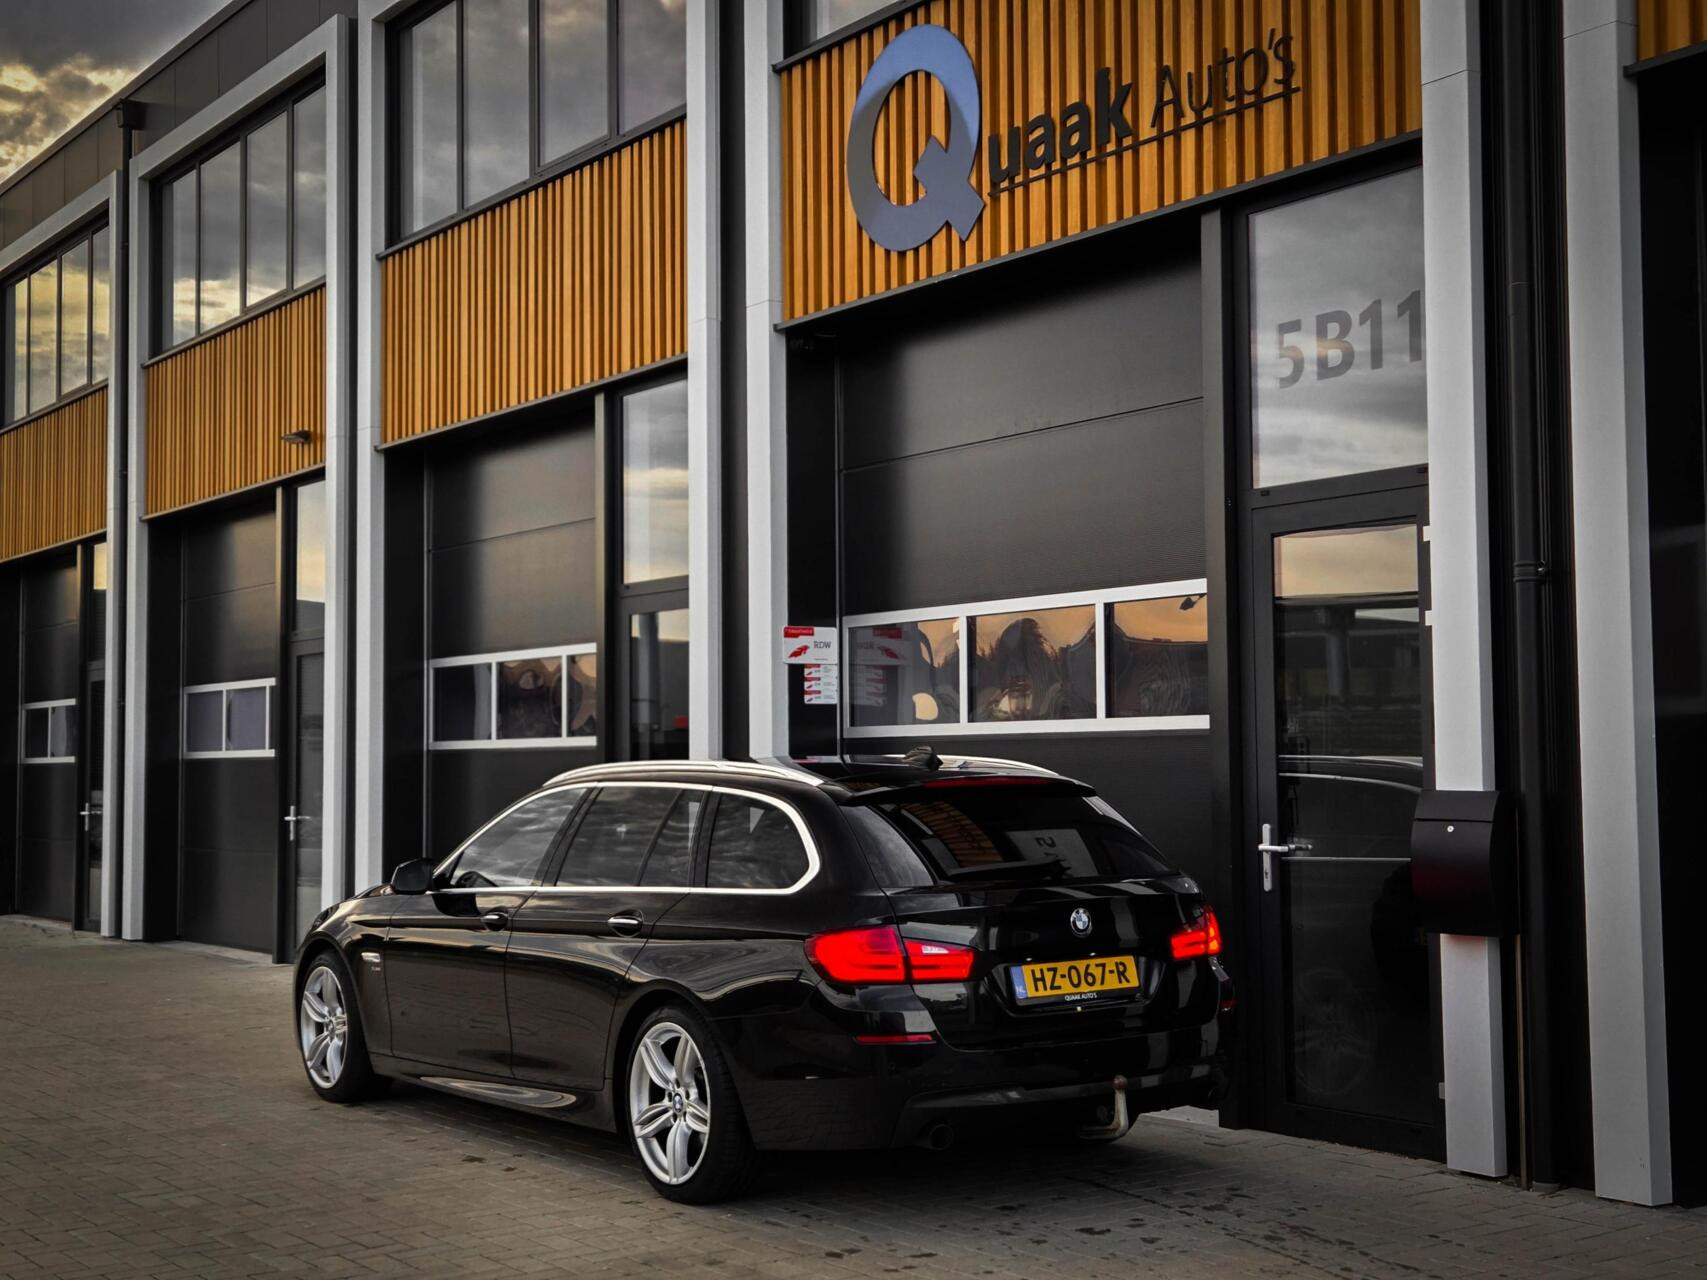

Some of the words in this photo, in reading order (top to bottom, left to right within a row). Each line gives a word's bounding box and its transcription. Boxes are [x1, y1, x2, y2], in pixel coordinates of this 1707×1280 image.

[847, 23, 1133, 252] Quaak
[1150, 27, 1296, 129] Auto's
[1277, 289, 1423, 389] 5B11
[813, 640, 832, 649] RDW
[1015, 986, 1026, 994] NL
[1031, 960, 1130, 992] HZ-067-R
